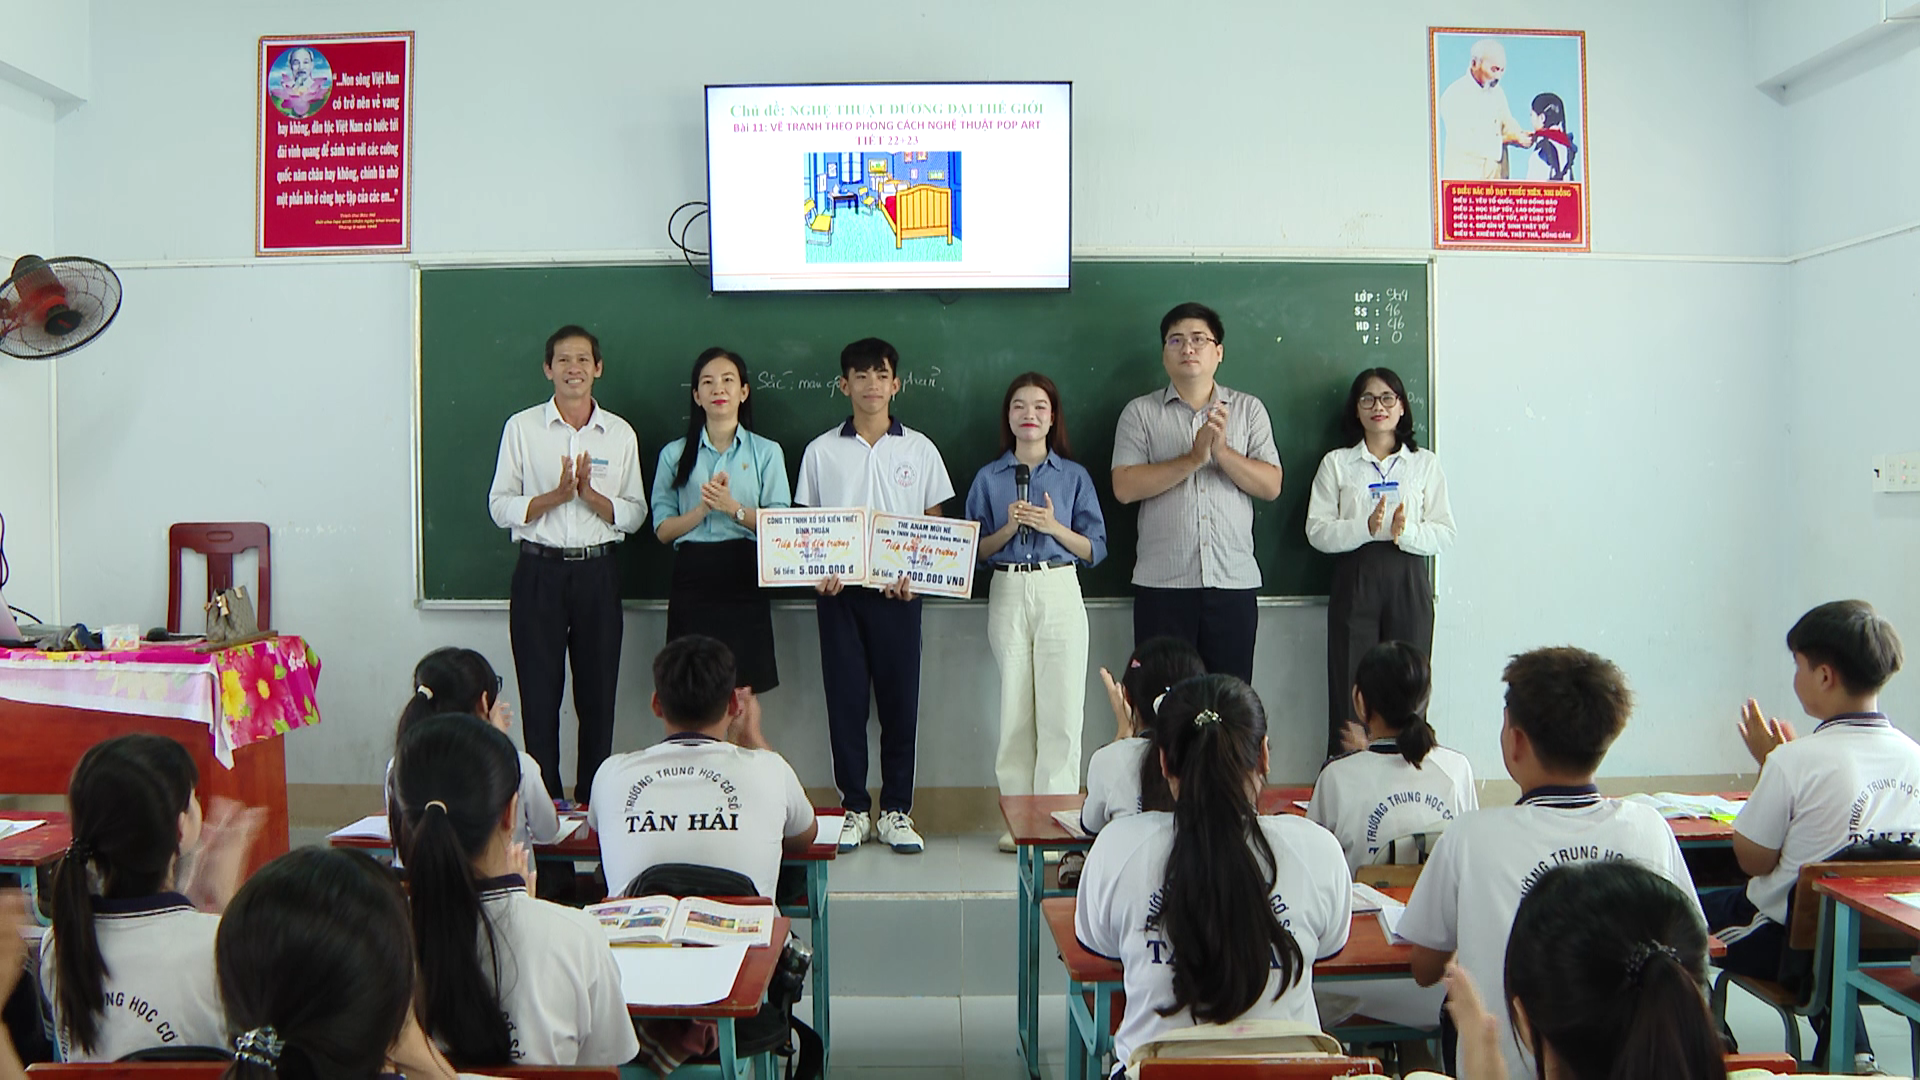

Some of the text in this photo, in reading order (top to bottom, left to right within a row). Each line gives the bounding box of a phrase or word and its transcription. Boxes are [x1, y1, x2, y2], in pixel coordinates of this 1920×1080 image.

[356, 73, 370, 88] sông
[372, 71, 384, 88] Việt
[386, 71, 399, 84] Nam
[332, 96, 341, 110] có
[343, 93, 355, 110] trở
[356, 95, 370, 109] nên
[382, 97, 399, 110] vang
[730, 104, 759, 118] Chủ
[764, 100, 785, 117] đề:
[790, 104, 832, 118] NGHỆ
[834, 104, 885, 118] THUẬT
[976, 100, 1007, 114] THẾ
[1011, 100, 1043, 114] GIỚI
[733, 118, 1041, 133] Bài 11: VẼ TRANH THEO PHONG CÁCH NGHỆ THUẬT POP ART
[855, 133, 919, 146] TIẾT 22+23
[1385, 303, 1401, 317] 46
[1387, 315, 1405, 330] 46
[1391, 330, 1402, 344] 0
[767, 516, 782, 524] CÔNG
[809, 514, 817, 523] XỔ
[818, 515, 826, 523] SỐ
[827, 514, 840, 523] KIẾN
[842, 513, 858, 523] THIẾT
[811, 526, 830, 536] THUẬN
[898, 521, 951, 534] THE ANAM MŨI NÉ
[773, 566, 781, 575] Số
[782, 566, 795, 575] tiền:
[872, 567, 879, 576] Số
[881, 568, 894, 578] tiền:
[624, 766, 742, 814] TRƯỜNG TRUNG HỌC CƠ SỞ
[1849, 778, 1919, 832] TRƯỜNG TRUNG HỌC
[625, 807, 739, 834] TÂN HẢI
[1367, 791, 1444, 843] TRƯỜNG TRUNG HỌC
[1550, 845, 1598, 866] TRUNG
[1270, 894, 1289, 915] CƠ
[129, 996, 158, 1023] HỌC
[156, 1021, 179, 1043] CƠ
